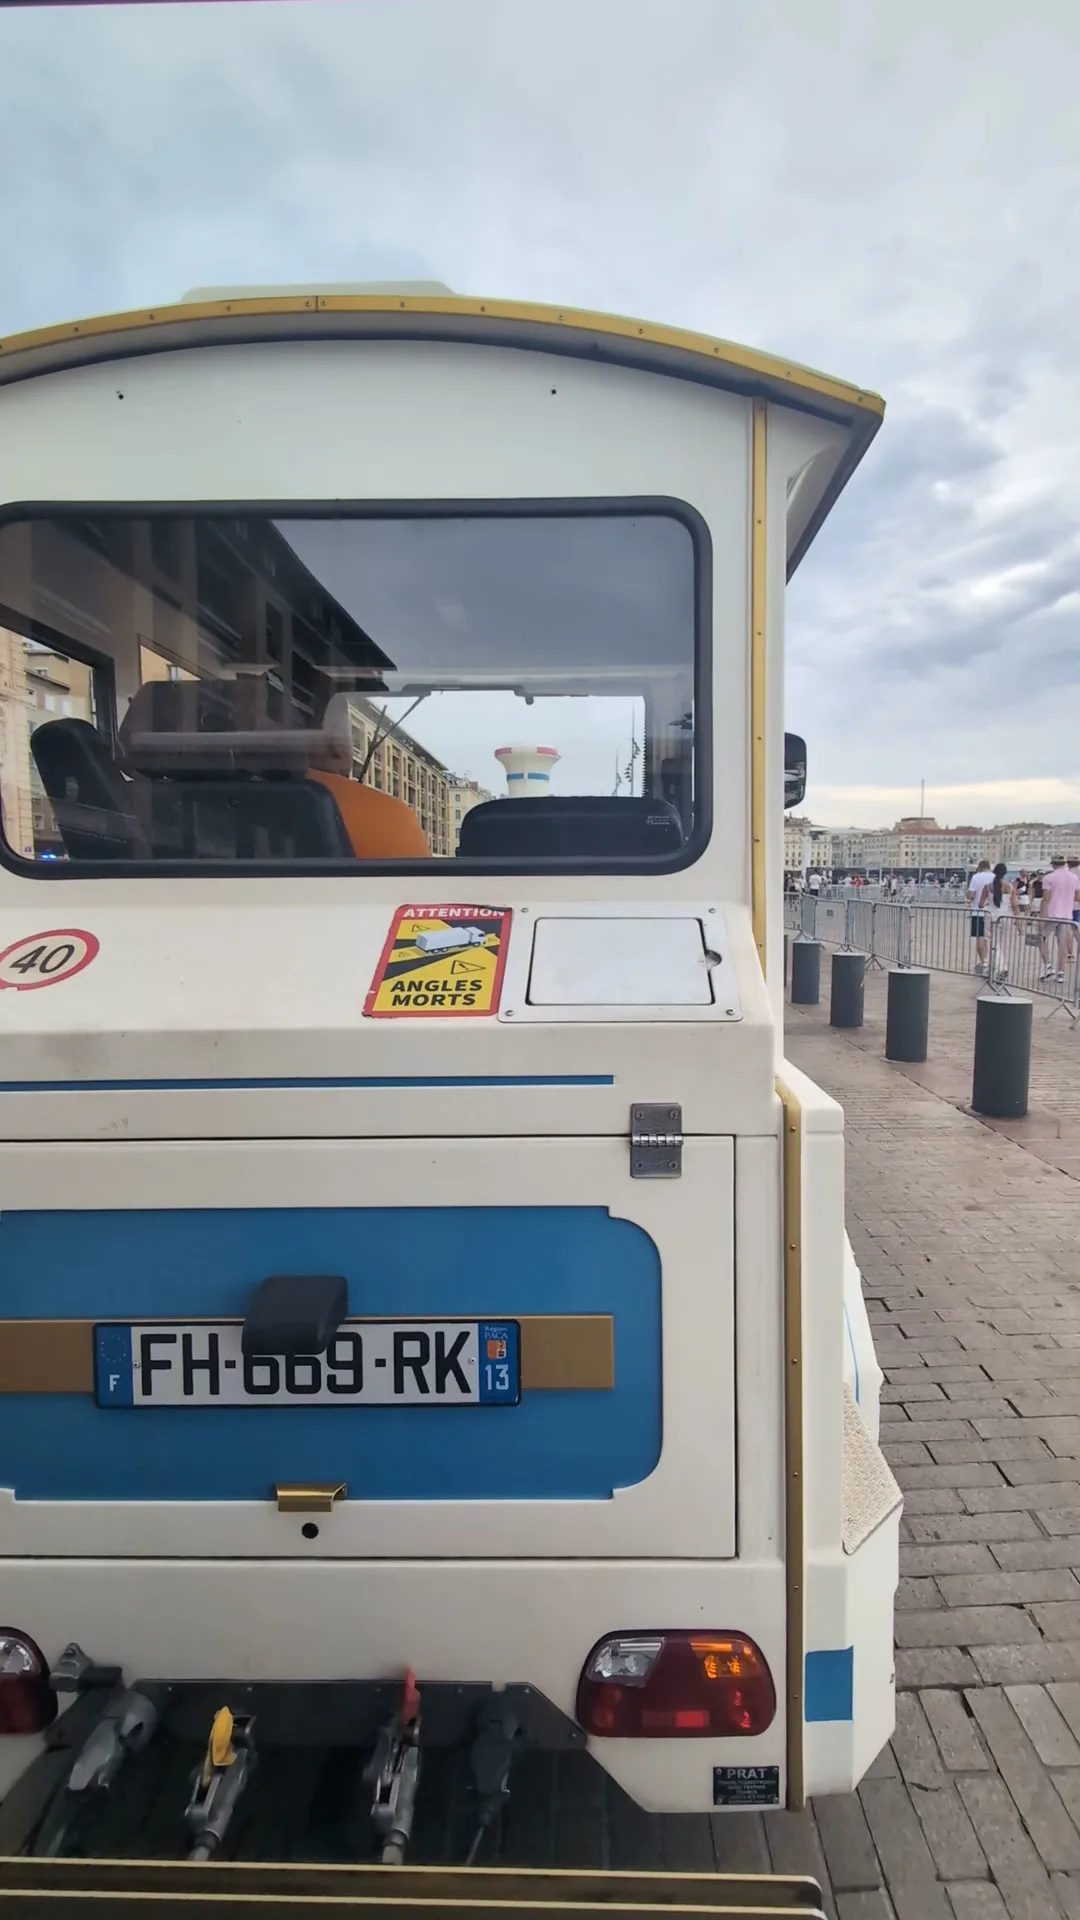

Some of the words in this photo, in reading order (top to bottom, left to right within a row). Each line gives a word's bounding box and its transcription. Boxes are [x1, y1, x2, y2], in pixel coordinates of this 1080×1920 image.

[403, 908, 505, 917] ATTENTION
[9, 944, 75, 974] 40
[390, 979, 483, 992] ANGLES
[392, 993, 476, 1007] MORTS
[485, 1332, 508, 1340] PACA
[139, 1330, 473, 1396] FH-669-RK
[109, 1374, 118, 1391] F
[484, 1363, 509, 1391] 13
[727, 1768, 767, 1779] PRAT
